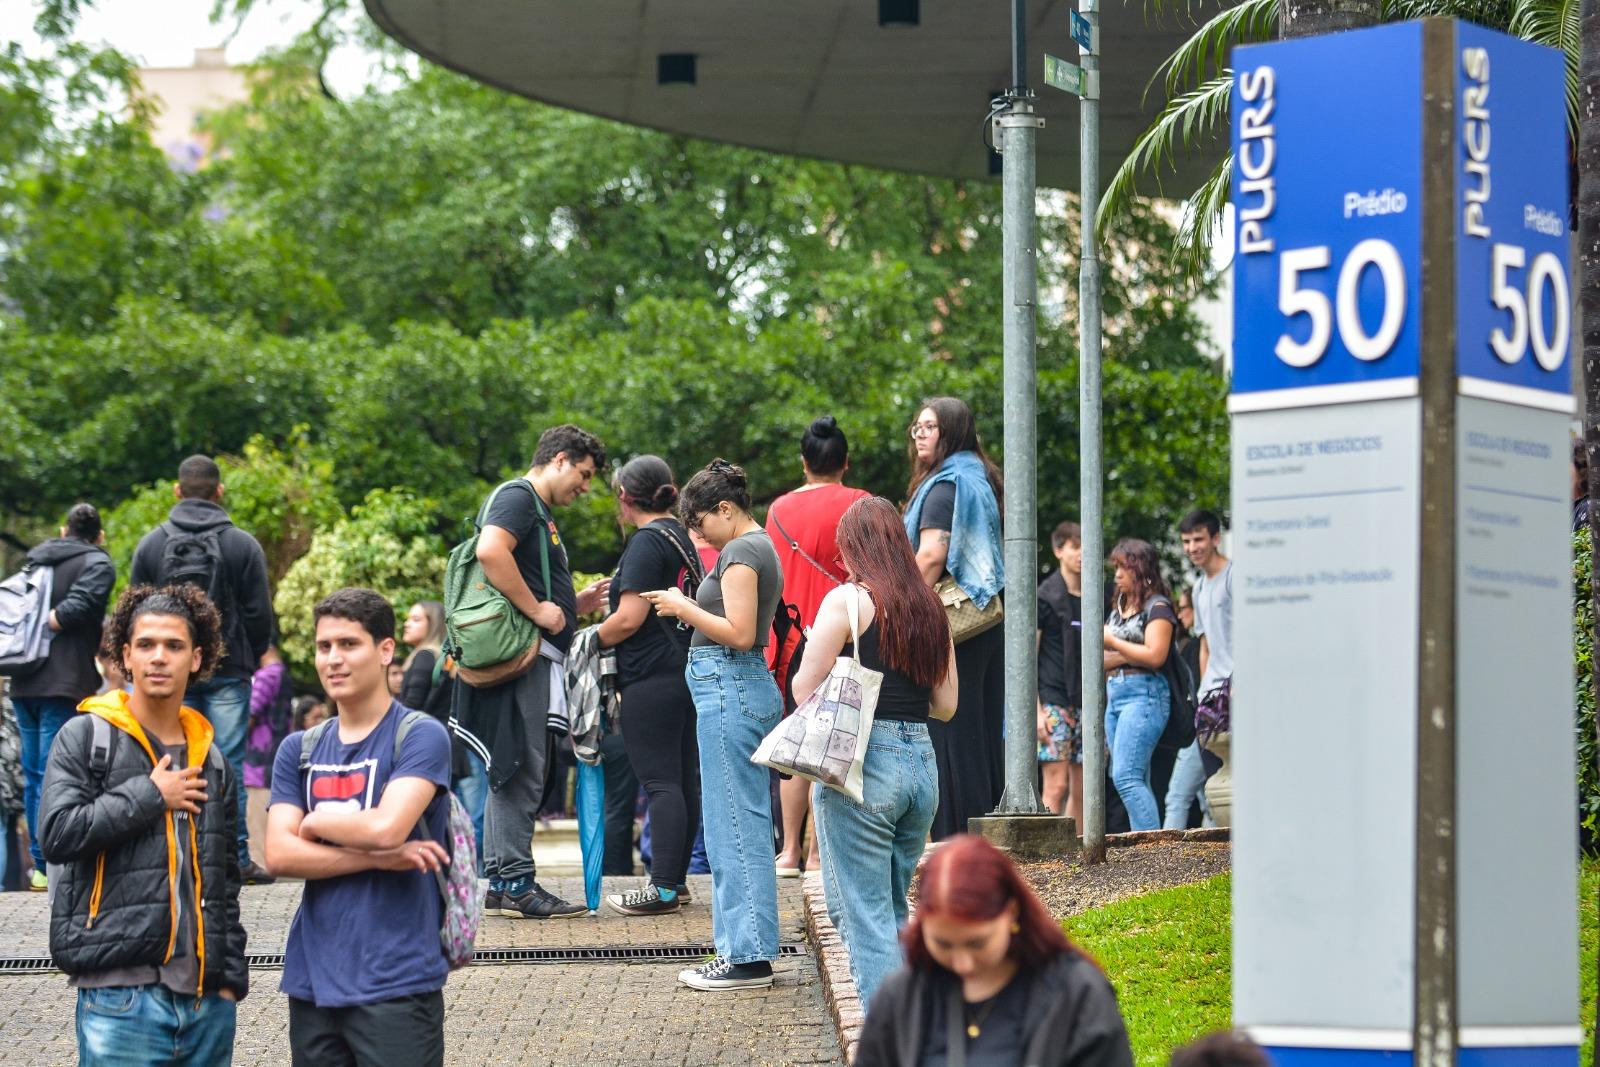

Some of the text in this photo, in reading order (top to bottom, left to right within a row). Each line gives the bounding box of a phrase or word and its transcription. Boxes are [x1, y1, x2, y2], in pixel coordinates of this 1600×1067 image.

[1240, 65, 1274, 254] PUCRS
[1344, 187, 1407, 218] Prédio
[1463, 47, 1491, 238] PUCRS
[1275, 238, 1407, 367] 50
[1491, 243, 1570, 371] 50
[1247, 443, 1294, 461] ESCOLA
[1296, 440, 1313, 456] DE
